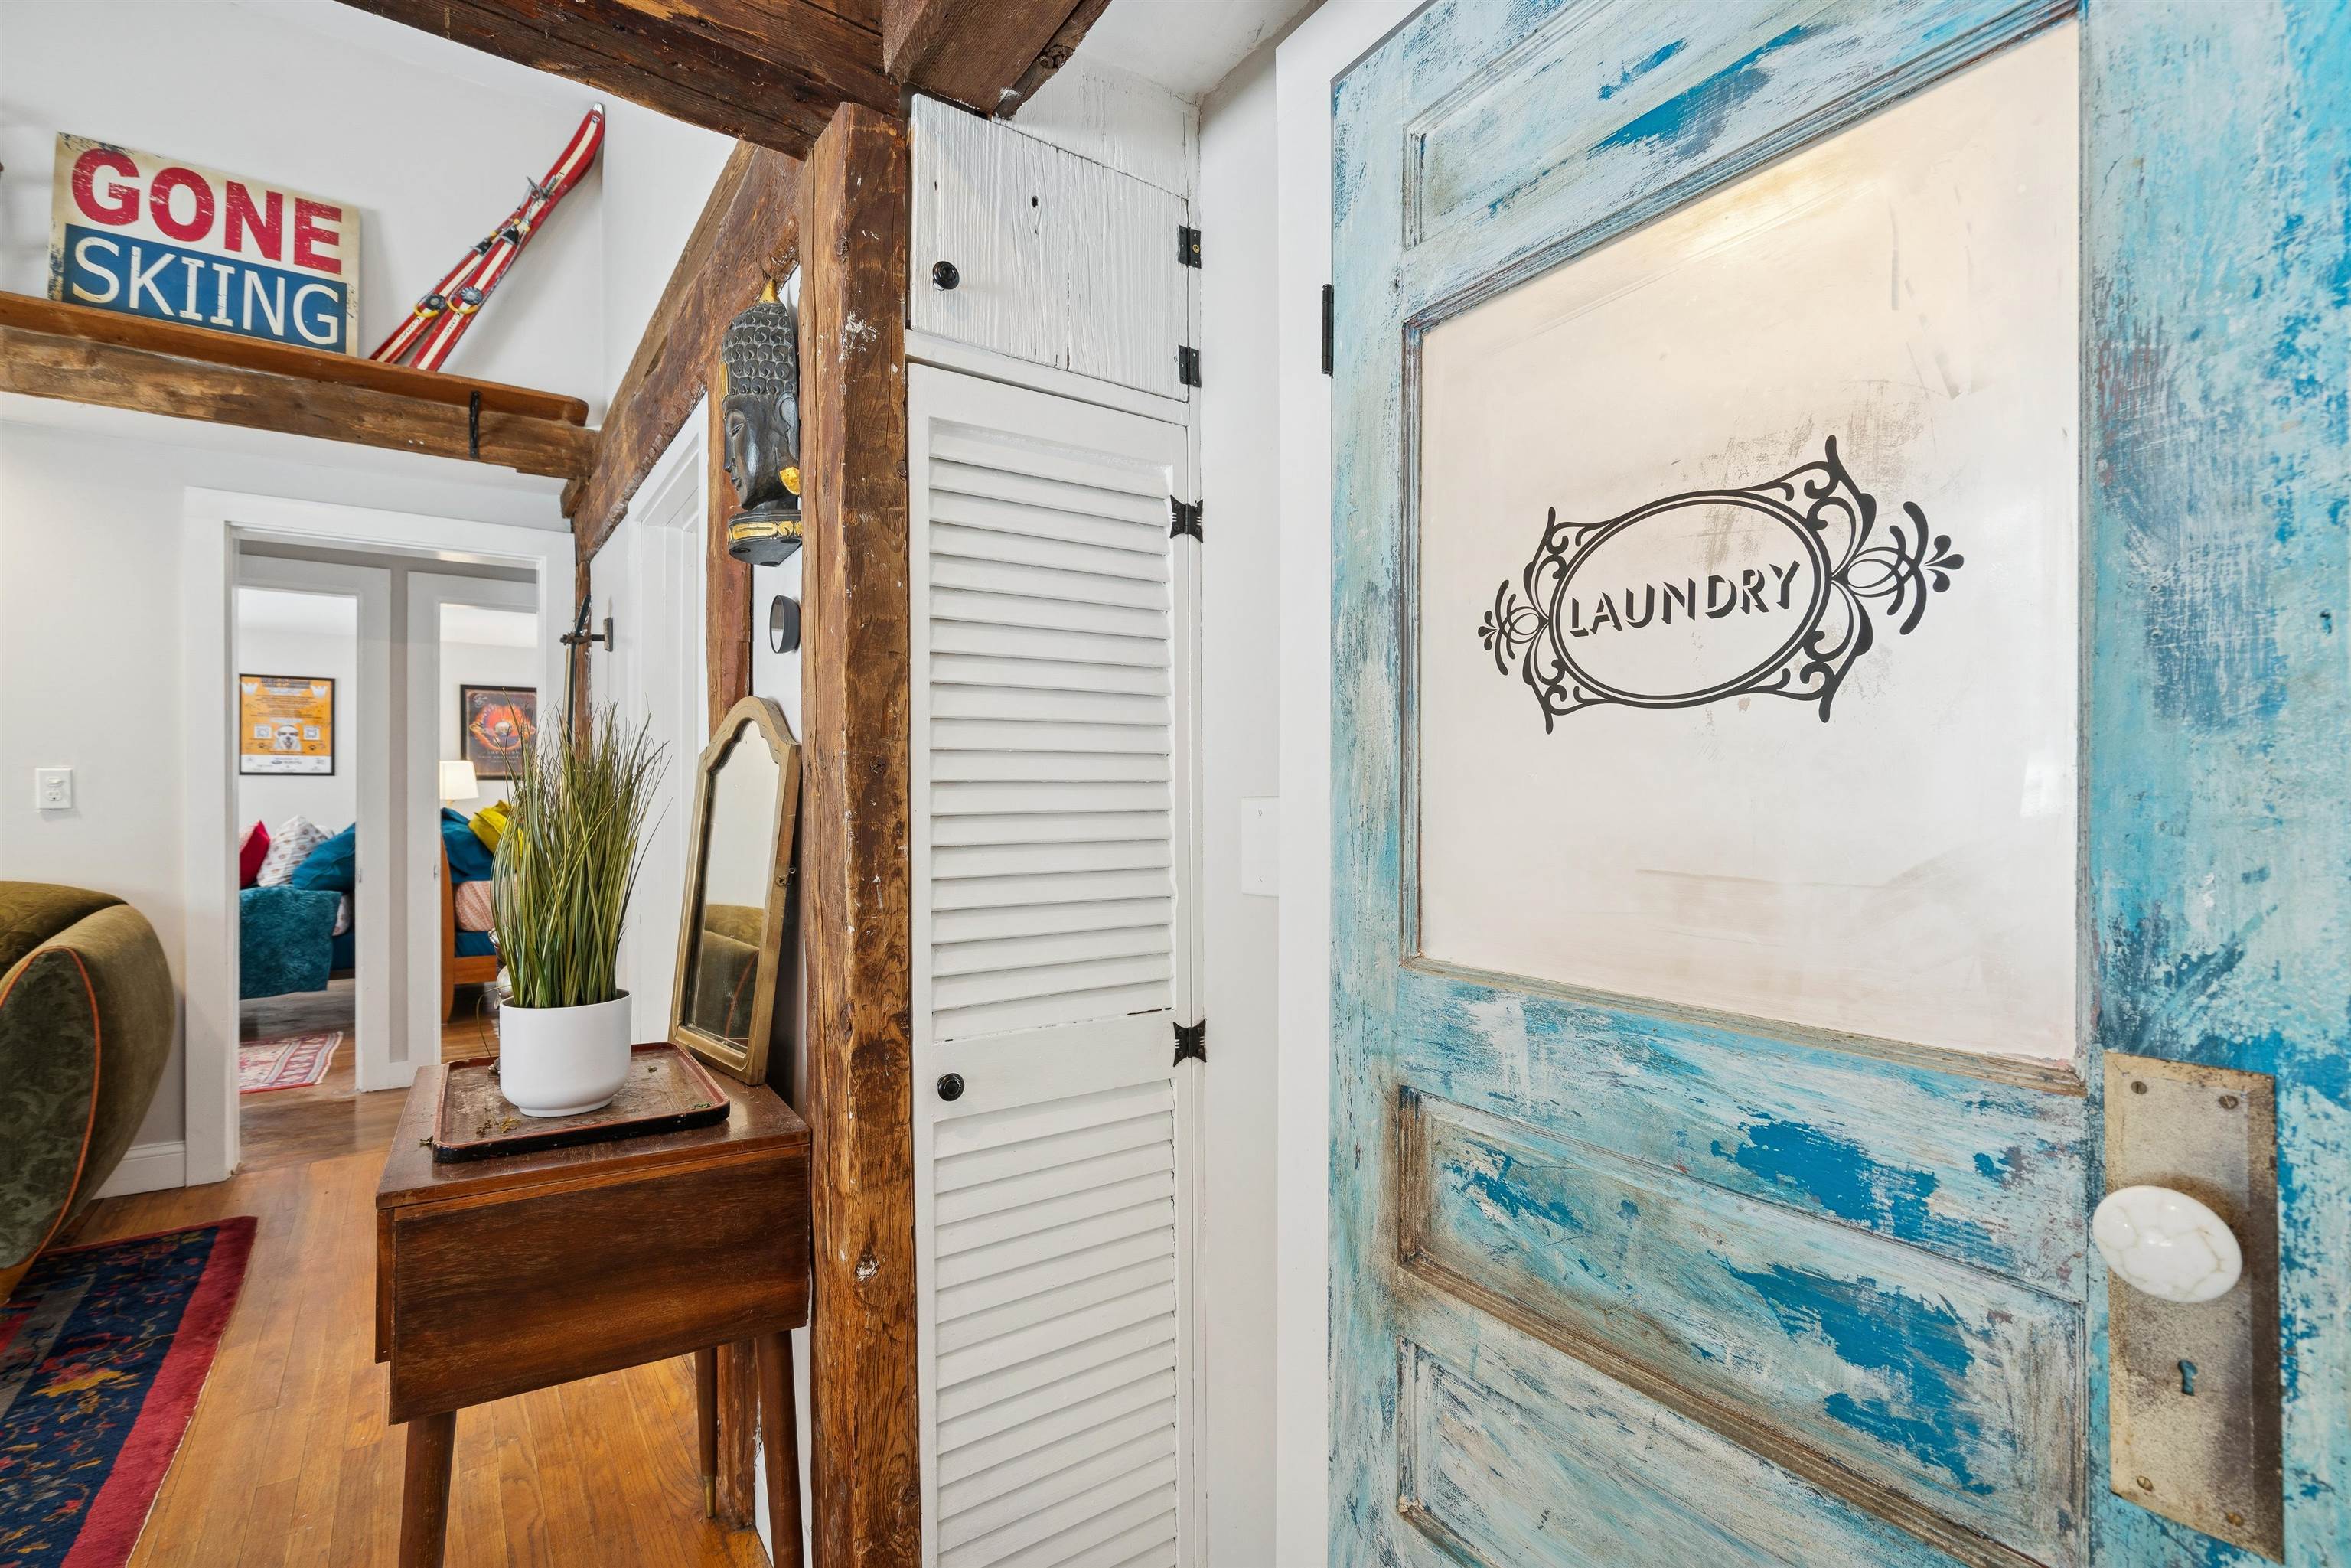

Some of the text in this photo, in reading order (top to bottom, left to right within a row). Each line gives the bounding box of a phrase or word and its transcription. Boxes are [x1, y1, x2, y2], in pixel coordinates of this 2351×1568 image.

[72, 148, 342, 275] GONE
[72, 236, 340, 344] SKIING
[1570, 560, 1801, 637] LAUNDRY
